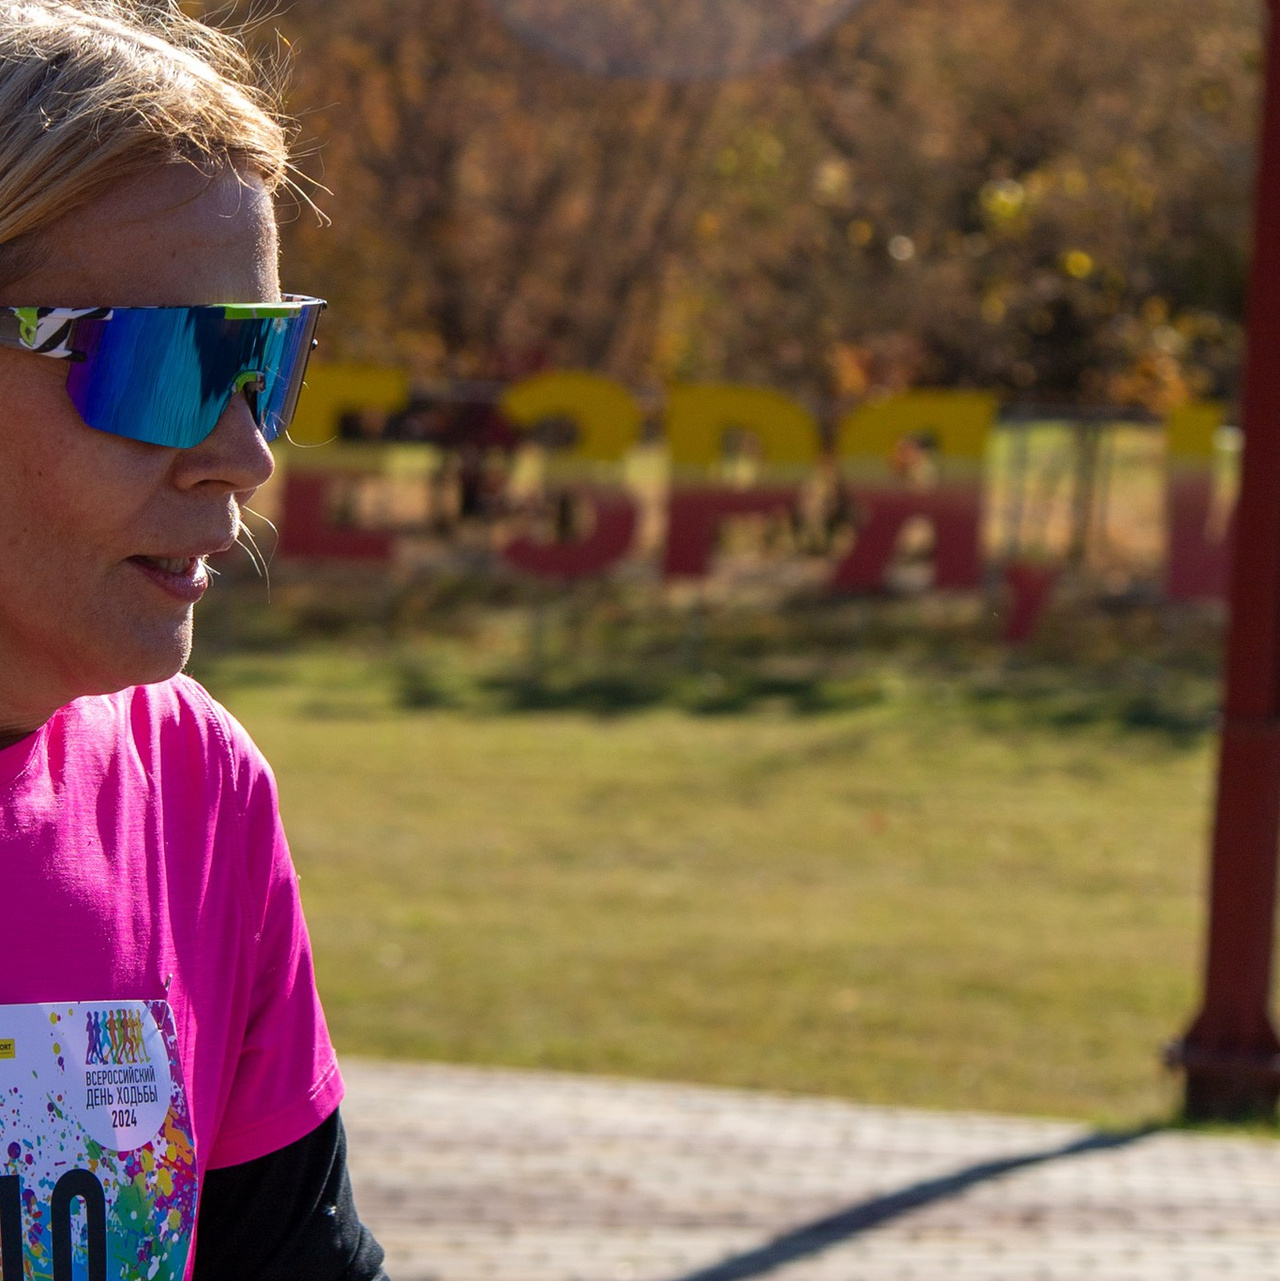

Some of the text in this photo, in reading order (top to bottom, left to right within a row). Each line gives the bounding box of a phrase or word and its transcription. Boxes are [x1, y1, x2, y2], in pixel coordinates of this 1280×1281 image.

[85, 1065, 156, 1086] ВСЕРОССИЙСКИЙ
[86, 1085, 158, 1110] ДЕНЬ ХОДЬБЫ
[111, 1109, 138, 1128] 2024
